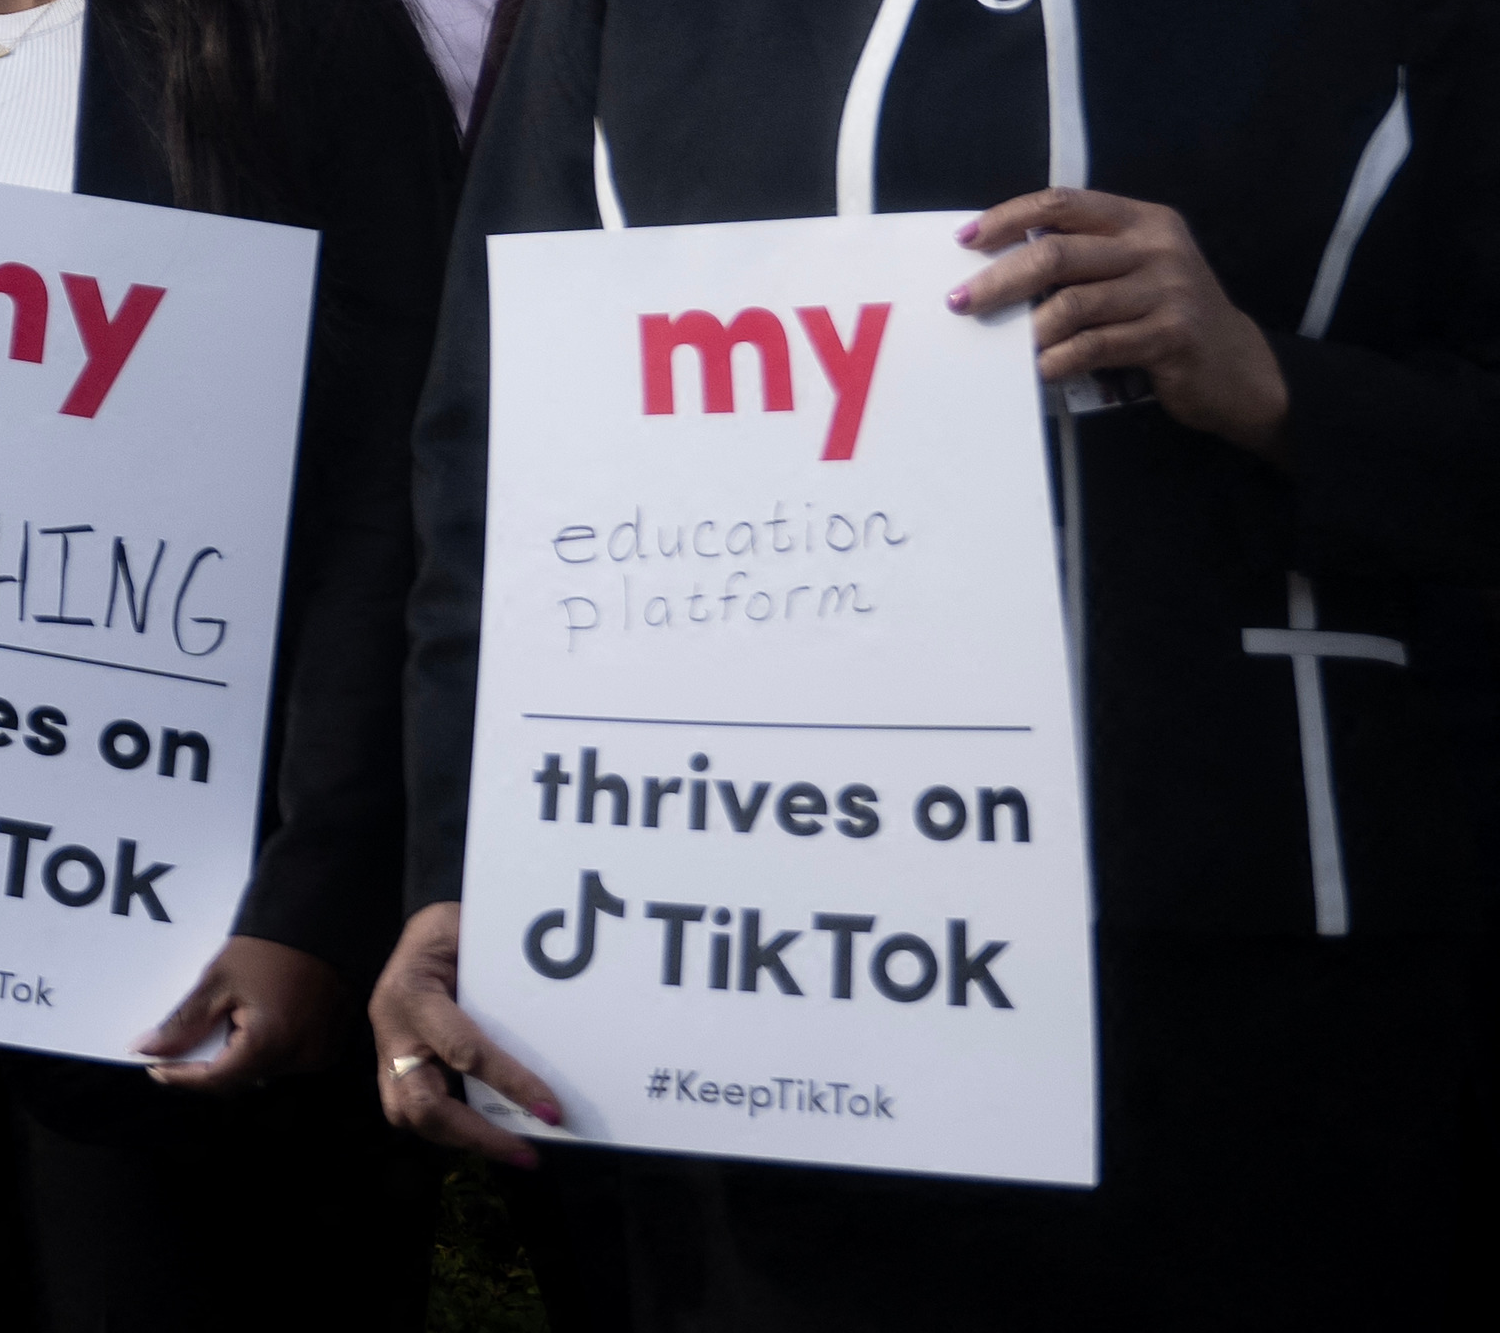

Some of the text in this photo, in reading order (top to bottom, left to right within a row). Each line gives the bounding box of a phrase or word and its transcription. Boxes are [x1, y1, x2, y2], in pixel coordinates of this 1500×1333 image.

[642, 306, 889, 460] my
[552, 500, 908, 564] education
[558, 569, 874, 652] platform
[100, 720, 210, 783] on
[535, 749, 1030, 842] thrives on
[647, 904, 1013, 1009] TikTok
[648, 1070, 892, 1118] #KeepTikTok
